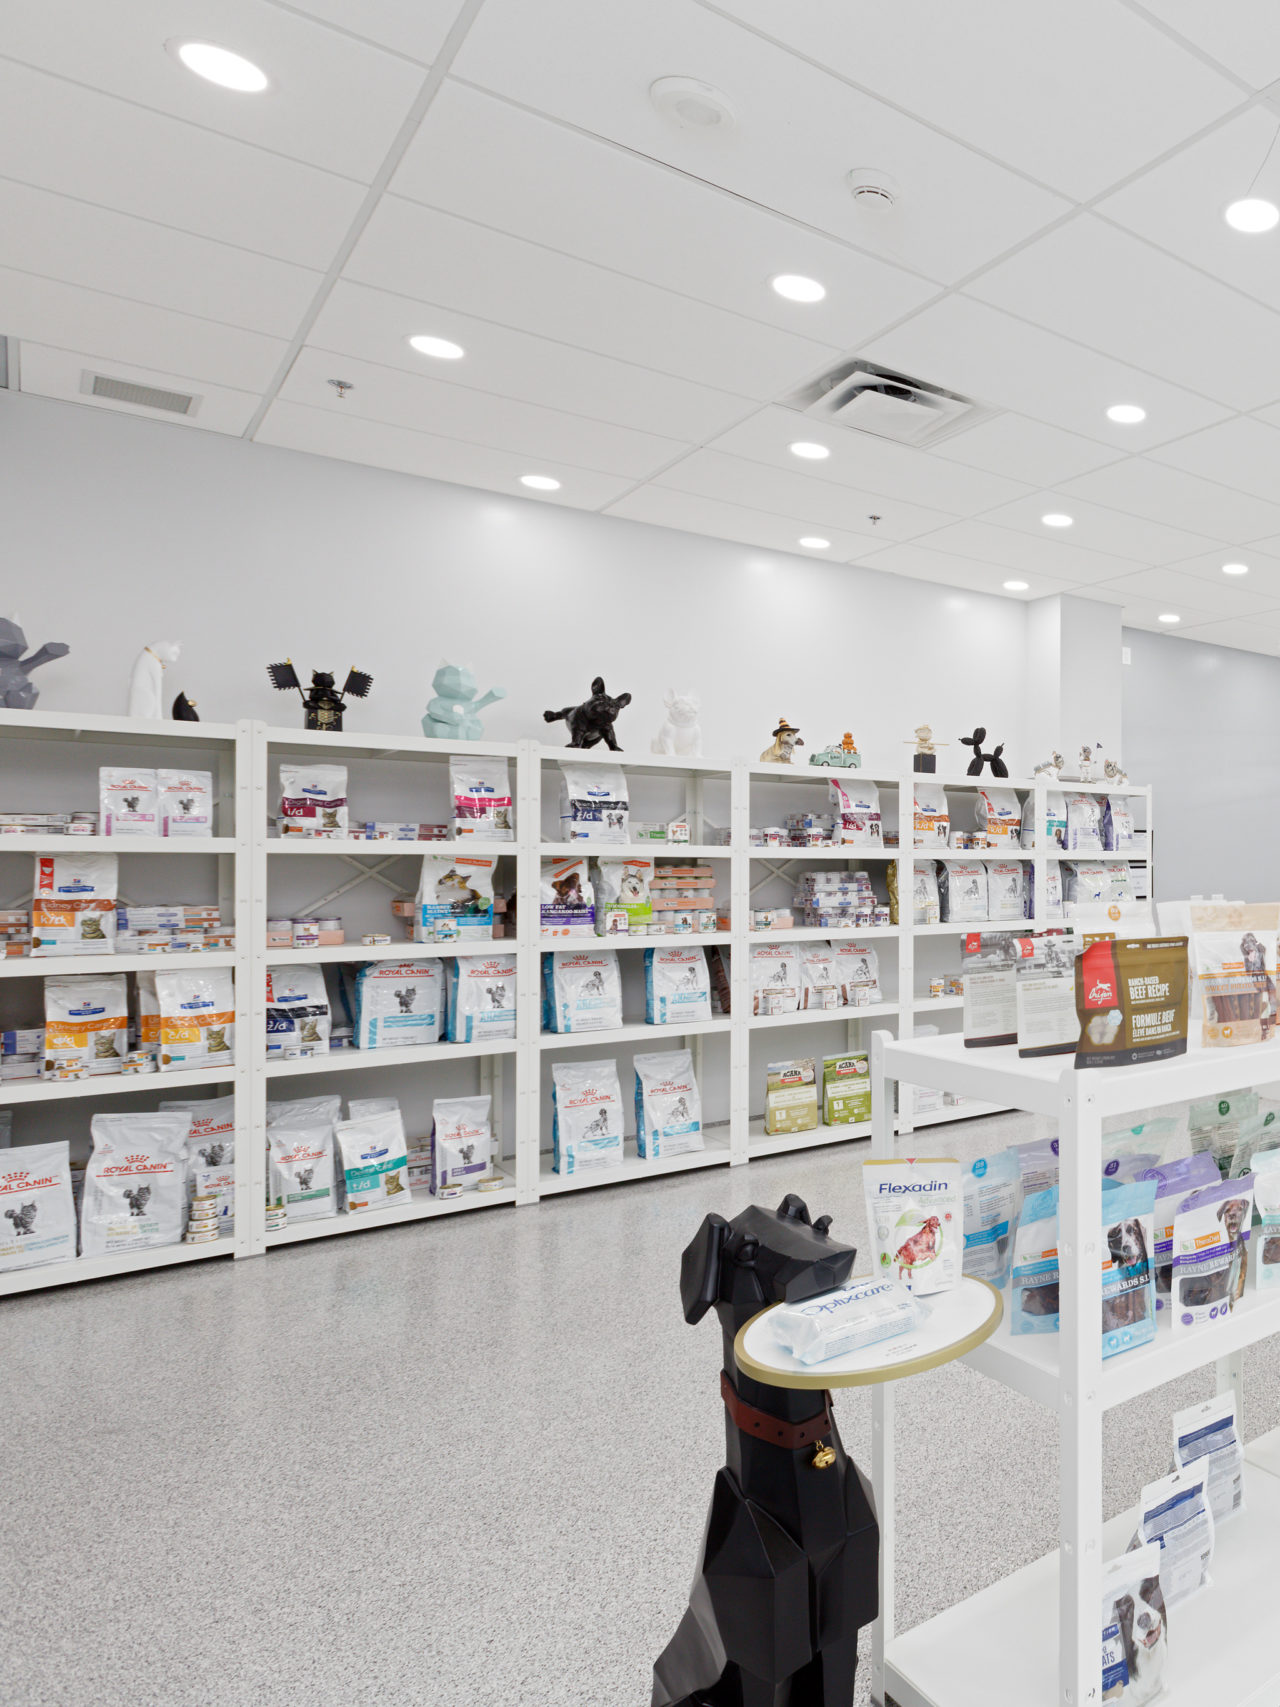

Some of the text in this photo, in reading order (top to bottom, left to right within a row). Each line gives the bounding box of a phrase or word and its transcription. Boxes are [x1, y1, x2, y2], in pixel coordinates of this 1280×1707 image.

[1129, 983, 1170, 1000] BEEF RECIPE
[1132, 1011, 1162, 1028] FORMULE
[104, 1163, 168, 1174] ROYAL CANIN
[16, 1176, 53, 1189] CANIN
[878, 1180, 949, 1194] Flexadin
[1022, 1273, 1051, 1285] RAYNE
[800, 1283, 891, 1316] Optixcare
